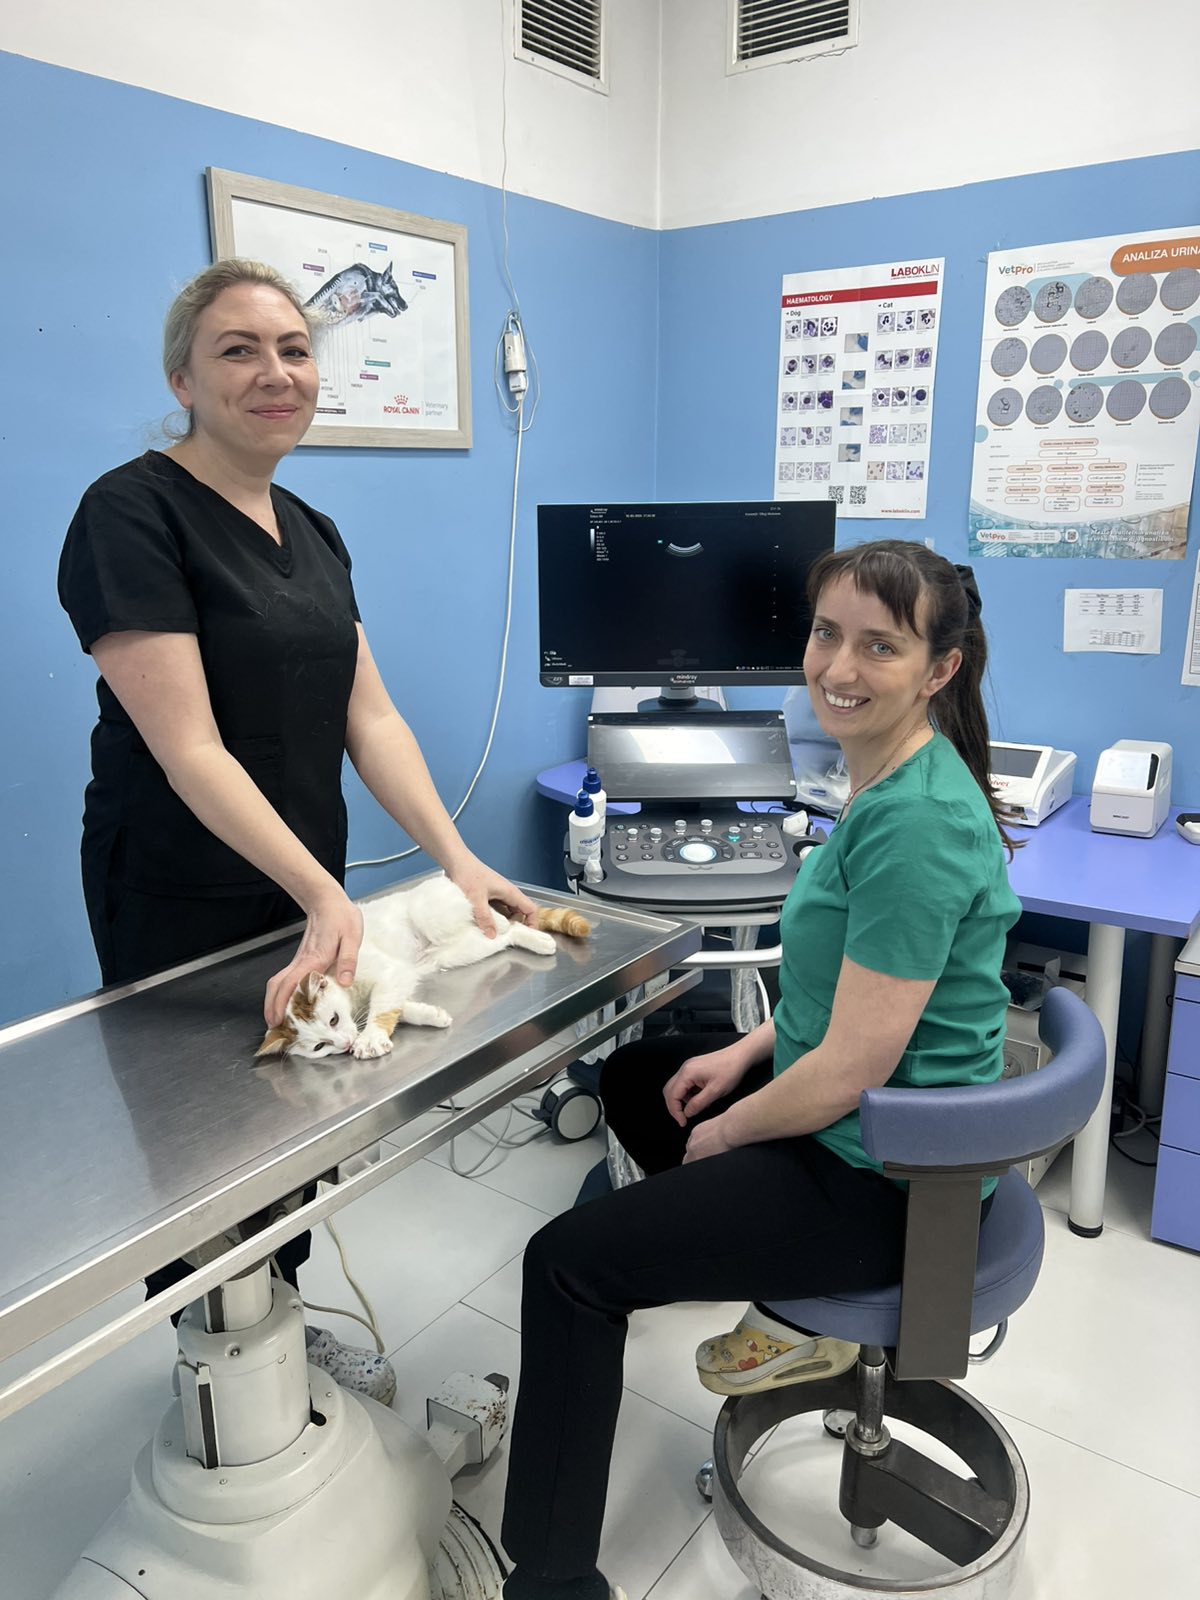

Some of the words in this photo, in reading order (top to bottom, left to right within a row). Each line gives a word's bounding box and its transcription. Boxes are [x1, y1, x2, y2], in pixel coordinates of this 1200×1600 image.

[1122, 249, 1168, 263] ANALIZA
[891, 264, 940, 277] LABOKLIN
[998, 264, 1034, 275] VetPro
[786, 295, 833, 305] HAEMATOLOGY
[383, 405, 401, 414] ROYAL
[401, 406, 420, 415] CANIN
[979, 531, 1006, 541] VetPro
